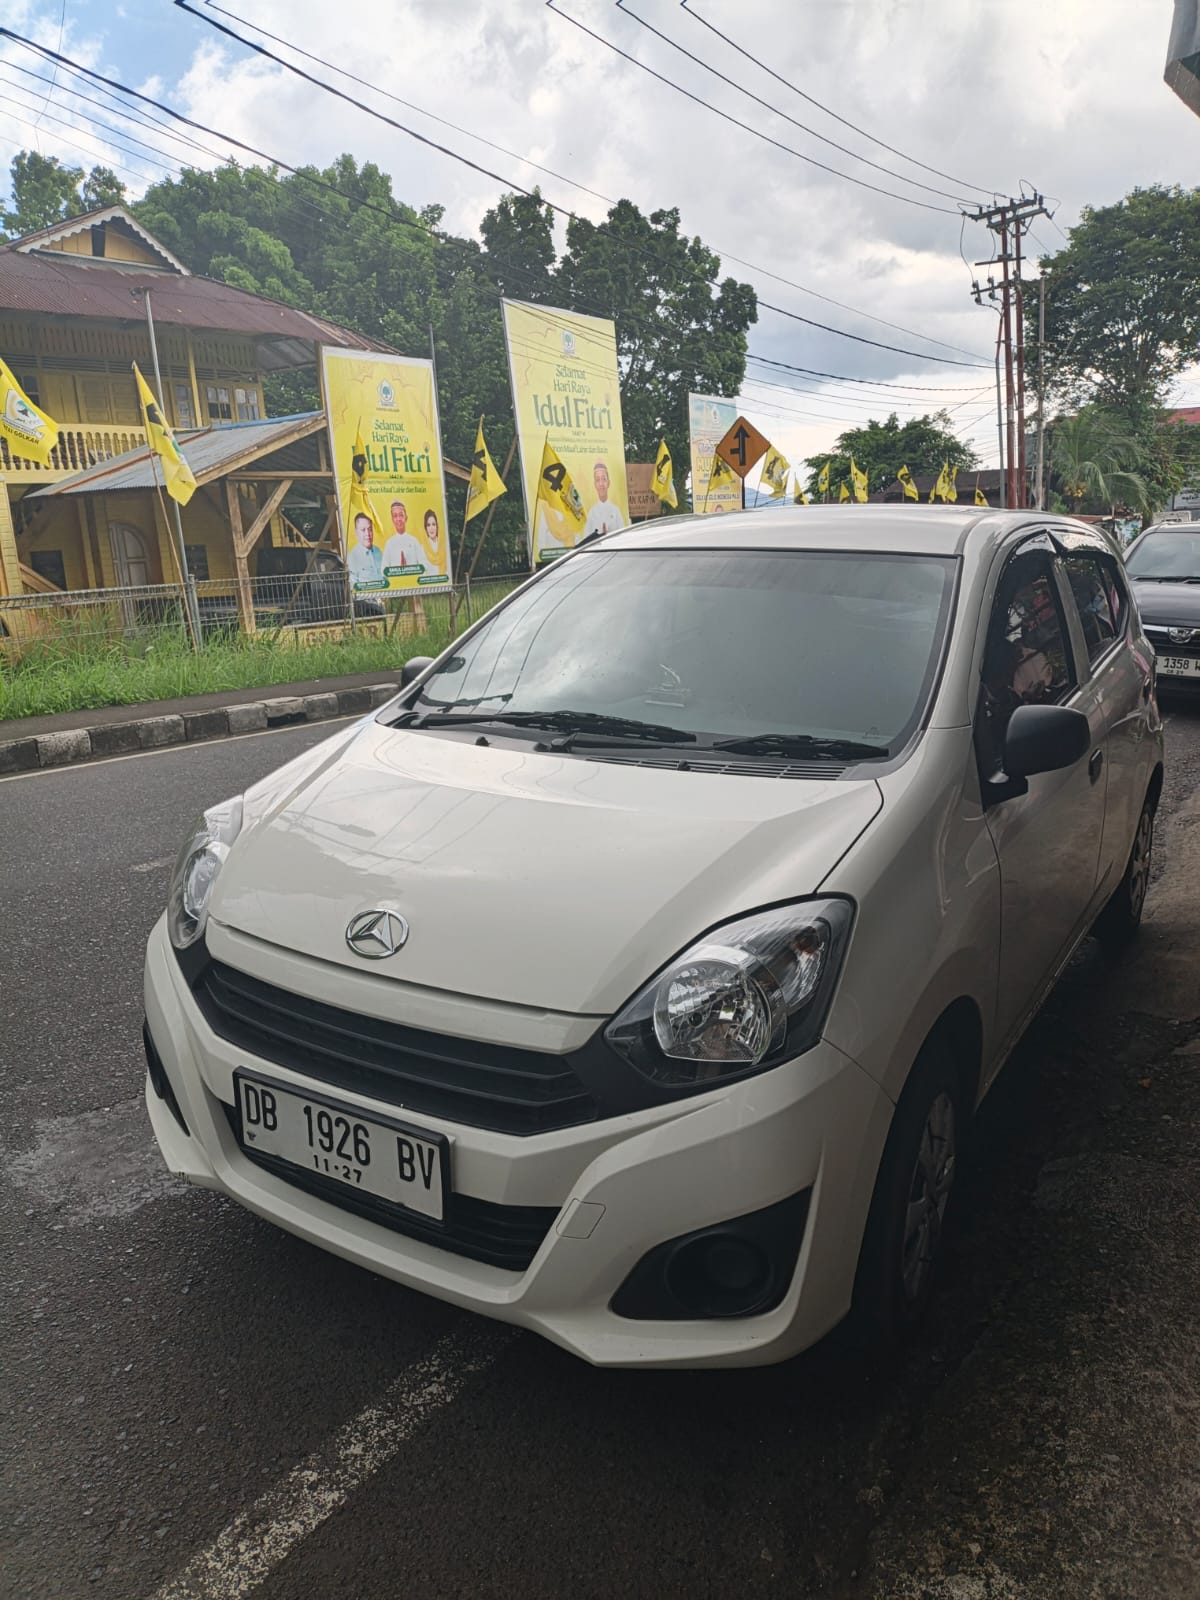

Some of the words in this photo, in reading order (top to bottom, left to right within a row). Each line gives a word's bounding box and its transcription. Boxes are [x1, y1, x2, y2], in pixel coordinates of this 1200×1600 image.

[555, 364, 586, 380] Selamat
[553, 379, 571, 393] Hari
[571, 381, 591, 396] Raya
[533, 394, 573, 427] Idul
[573, 398, 612, 430] Fitri
[374, 419, 405, 432] Selamat
[372, 431, 389, 443] Hari
[389, 432, 409, 446] Raya
[390, 446, 431, 473] Fitri
[543, 463, 567, 492] 4
[1163, 657, 1190, 670] 1358
[244, 1083, 278, 1131] DB
[303, 1104, 371, 1167] 1926
[396, 1136, 436, 1191] BV
